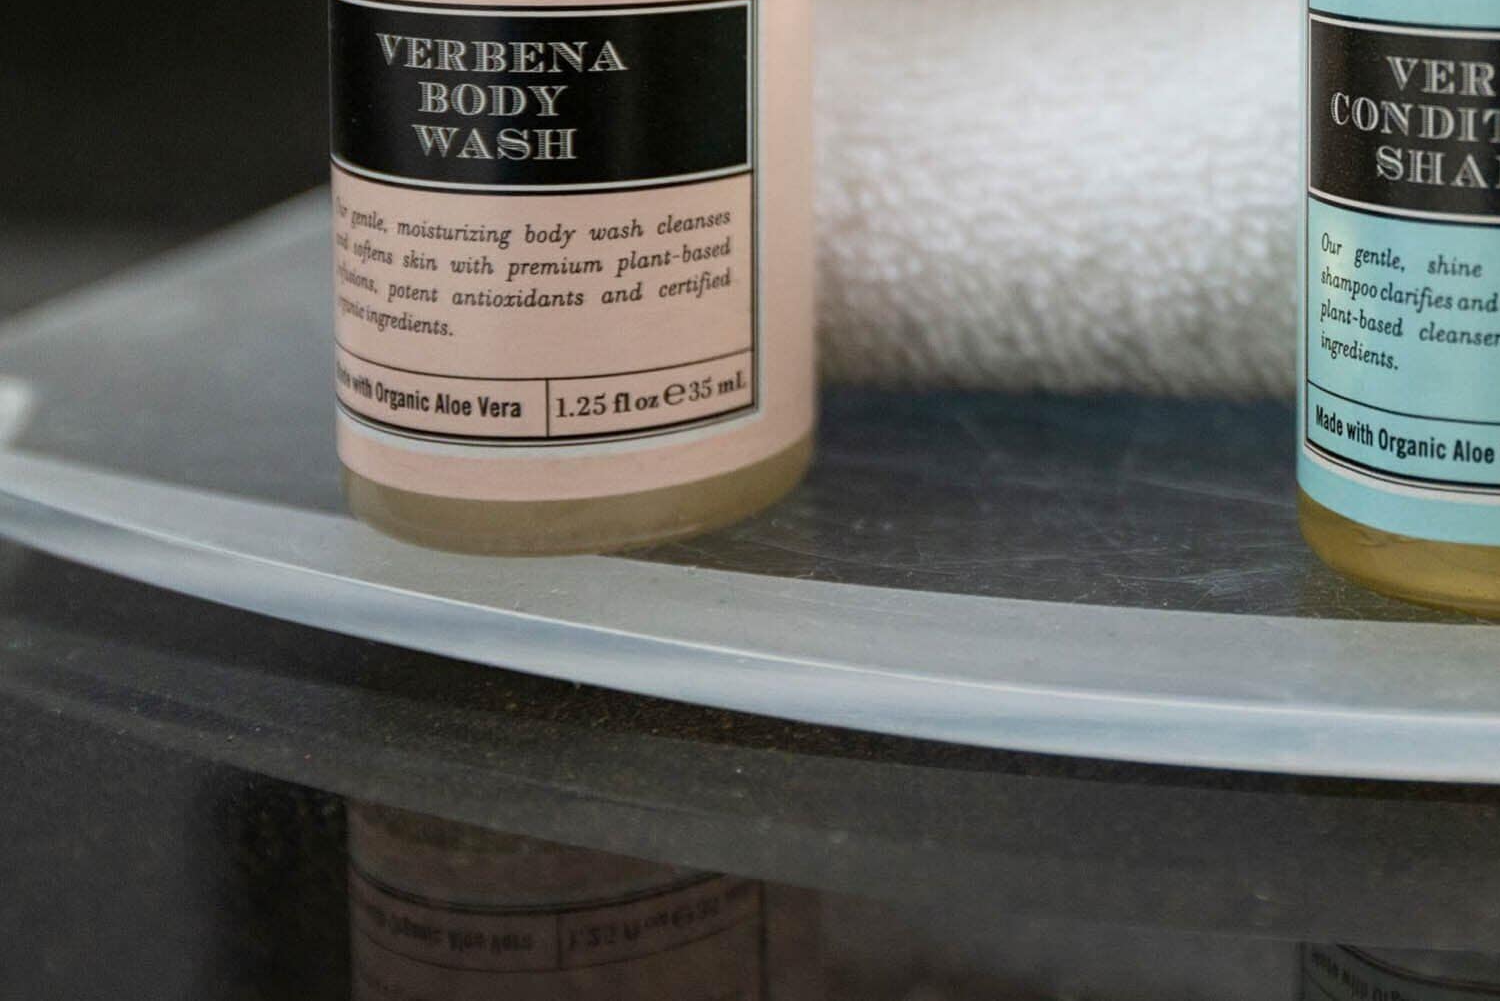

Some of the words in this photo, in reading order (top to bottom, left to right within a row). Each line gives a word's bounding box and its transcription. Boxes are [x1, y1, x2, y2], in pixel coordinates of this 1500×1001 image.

[376, 33, 629, 74] VERBENA
[418, 82, 568, 118] BODY
[412, 124, 577, 161] WASH
[397, 221, 512, 249] moisturizing
[525, 223, 576, 249] body
[590, 218, 644, 241] wash
[657, 210, 731, 235] cleanses
[402, 250, 438, 271] skin
[450, 257, 495, 275] with
[506, 255, 603, 282] premium
[616, 237, 731, 278] plant-based
[1321, 232, 1342, 256] Our
[1354, 247, 1405, 273] gentle,
[1427, 254, 1483, 279] shine
[388, 281, 438, 303] potent
[452, 288, 584, 308] antioxidants
[601, 282, 643, 304] and
[658, 267, 731, 299] certified
[1321, 267, 1377, 300] shampoo
[1380, 282, 1453, 314] clarifies
[1457, 292, 1498, 313] and
[366, 304, 454, 337] ingredients.
[1320, 300, 1403, 337] plant-based
[1321, 331, 1399, 370] ingredients.
[376, 381, 429, 411] Organic
[435, 393, 472, 416] Aloe
[477, 396, 521, 418] Vera
[555, 393, 606, 418] 1.25
[1316, 404, 1343, 435] Made
[1346, 422, 1373, 447] with
[1378, 428, 1446, 460] Organic
[1453, 440, 1495, 464] Aloe
